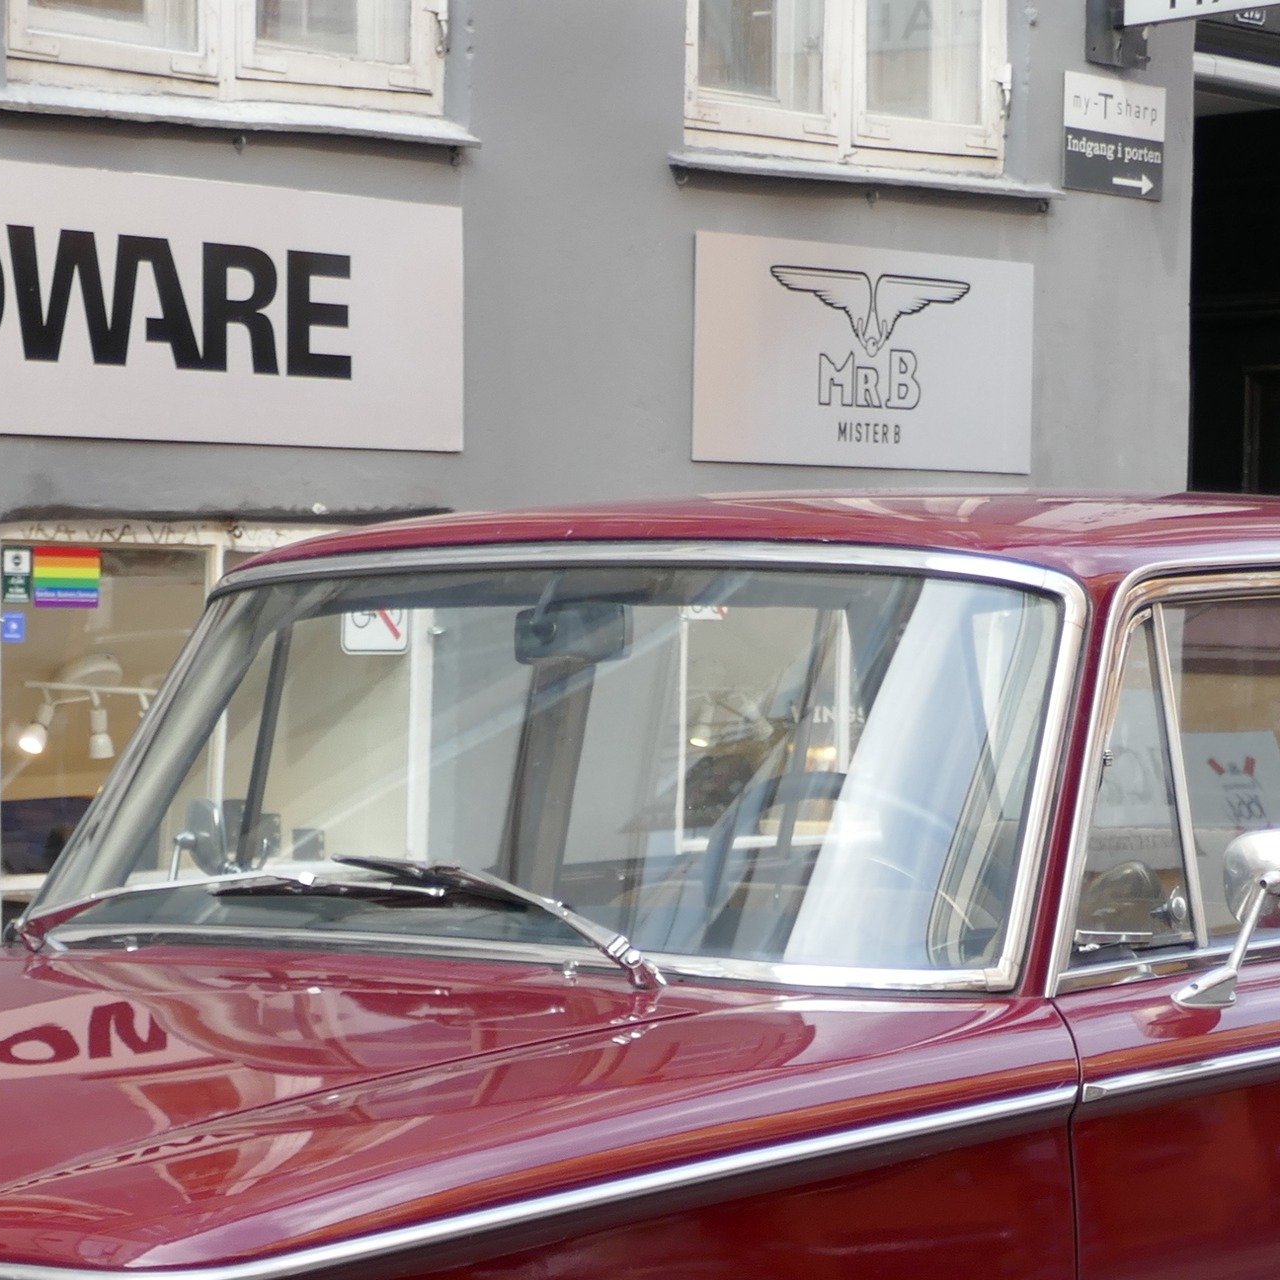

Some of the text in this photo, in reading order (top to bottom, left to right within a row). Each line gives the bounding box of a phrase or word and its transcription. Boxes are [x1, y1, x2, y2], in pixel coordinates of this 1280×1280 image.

[1116, 98, 1158, 127] sharp
[1066, 134, 1162, 164] Indgang i porten
[837, 421, 902, 444] MISTER B
